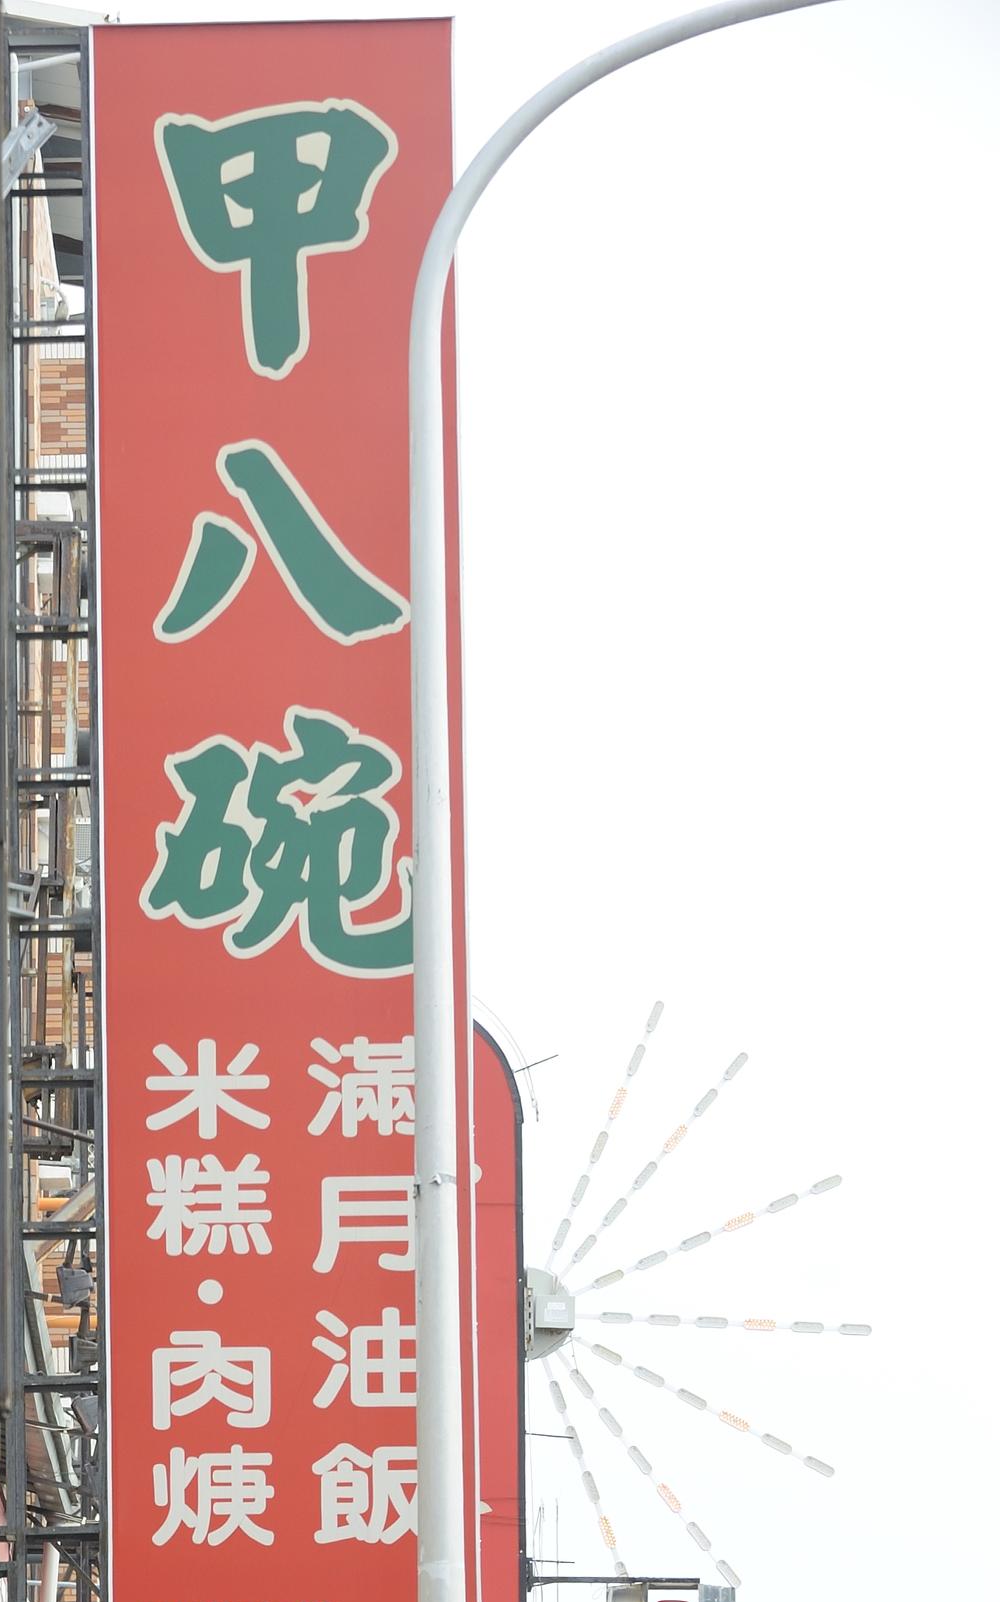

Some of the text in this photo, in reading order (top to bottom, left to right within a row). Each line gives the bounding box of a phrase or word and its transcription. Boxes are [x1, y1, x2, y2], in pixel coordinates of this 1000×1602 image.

[140, 98, 414, 980] 甲八碗
[307, 1035, 420, 1545] 滿月油飯
